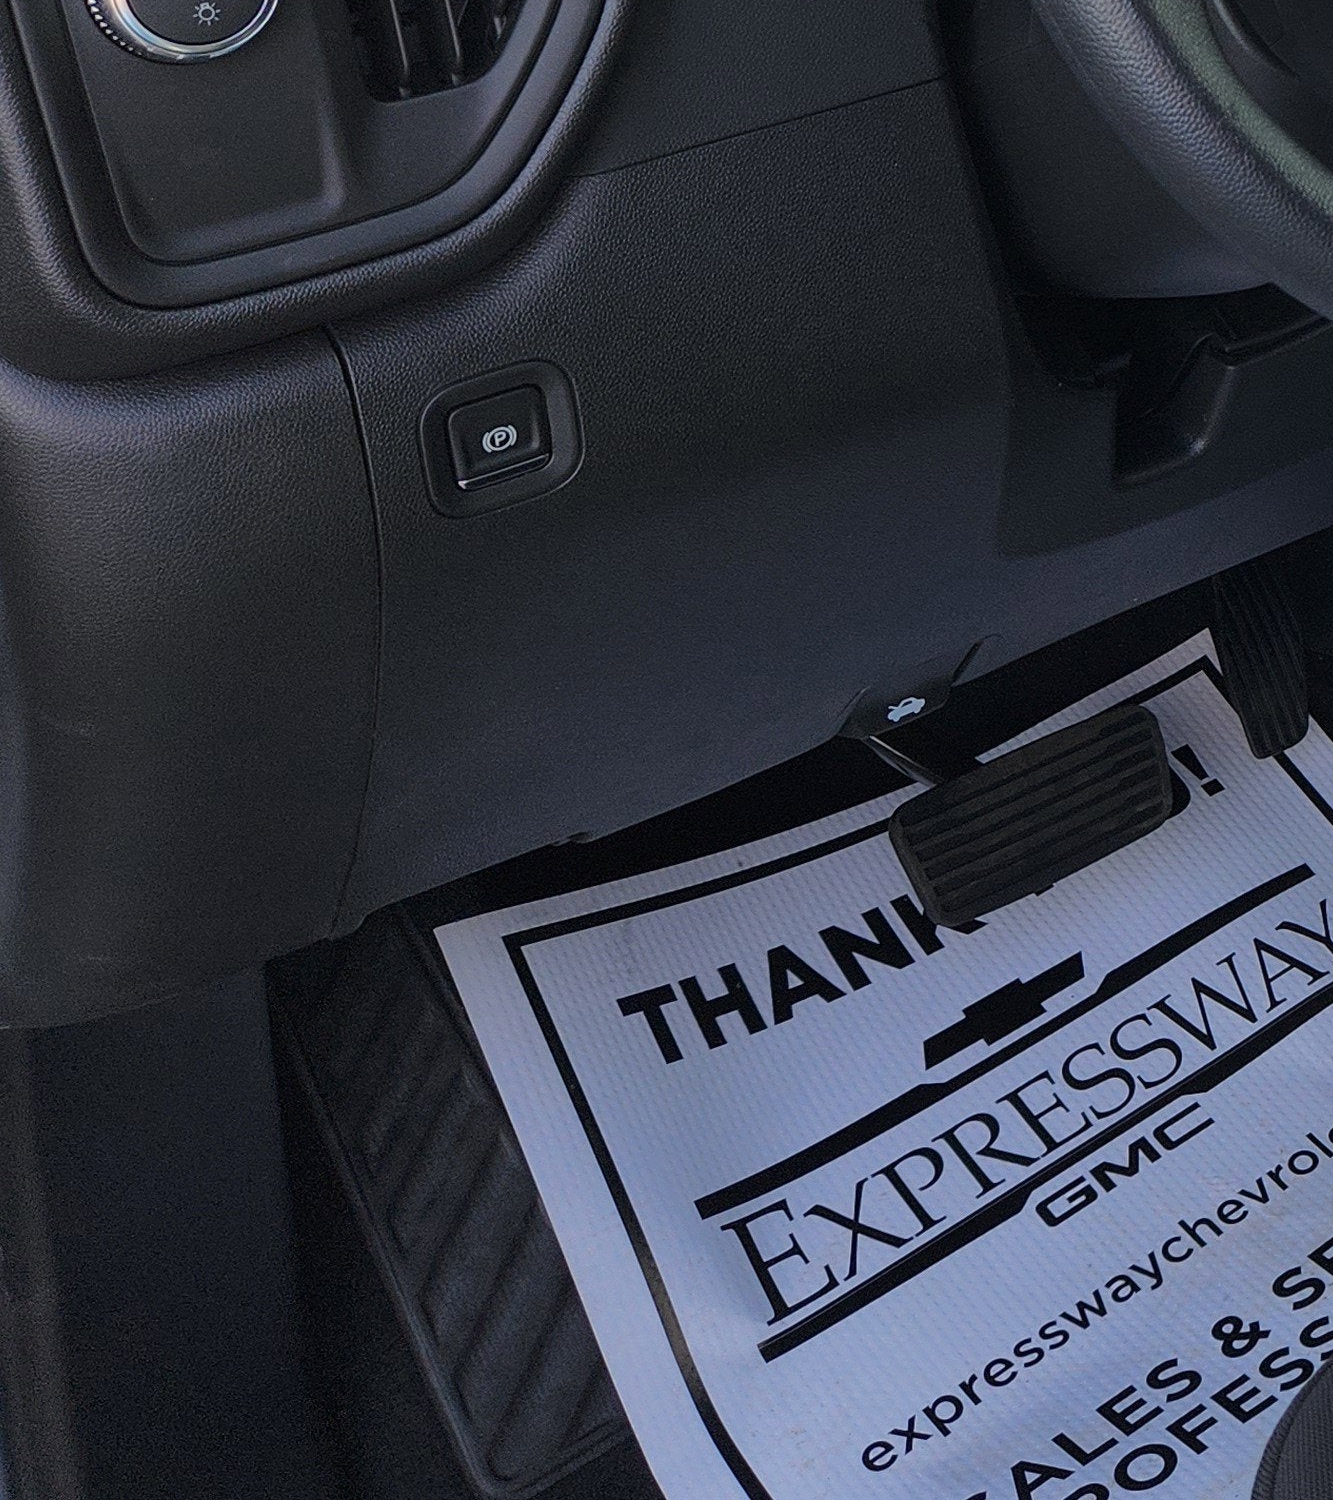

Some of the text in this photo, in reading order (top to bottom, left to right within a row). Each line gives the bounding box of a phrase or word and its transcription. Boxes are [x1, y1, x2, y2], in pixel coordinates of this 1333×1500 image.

[1035, 1101, 1215, 1227] GMC
[957, 1357, 1203, 1500] ALES
[1211, 1314, 1272, 1360] &
